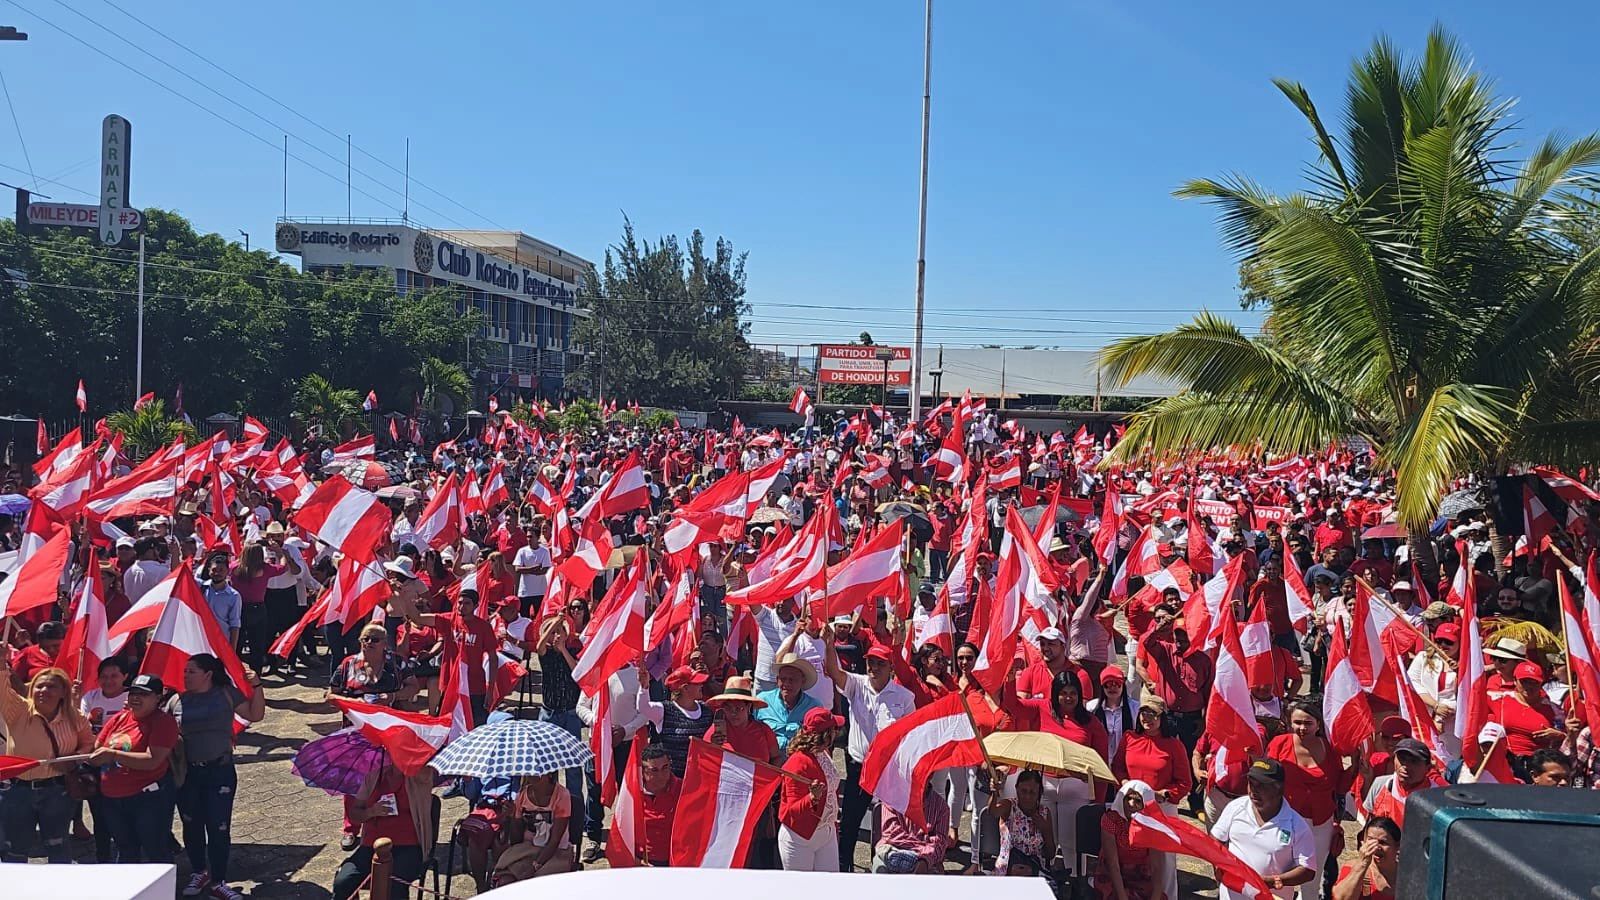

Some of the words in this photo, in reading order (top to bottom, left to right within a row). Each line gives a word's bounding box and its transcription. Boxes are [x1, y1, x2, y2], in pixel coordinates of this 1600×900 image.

[105, 116, 120, 242] FARMACIA
[30, 206, 97, 223] MILEYDE
[119, 212, 138, 225] #2
[301, 230, 348, 245] Edificio
[351, 232, 400, 246] Rotario
[437, 241, 471, 277] Club
[476, 252, 519, 291] Rotario
[826, 348, 867, 358] PARTIDO
[831, 372, 844, 381] DE
